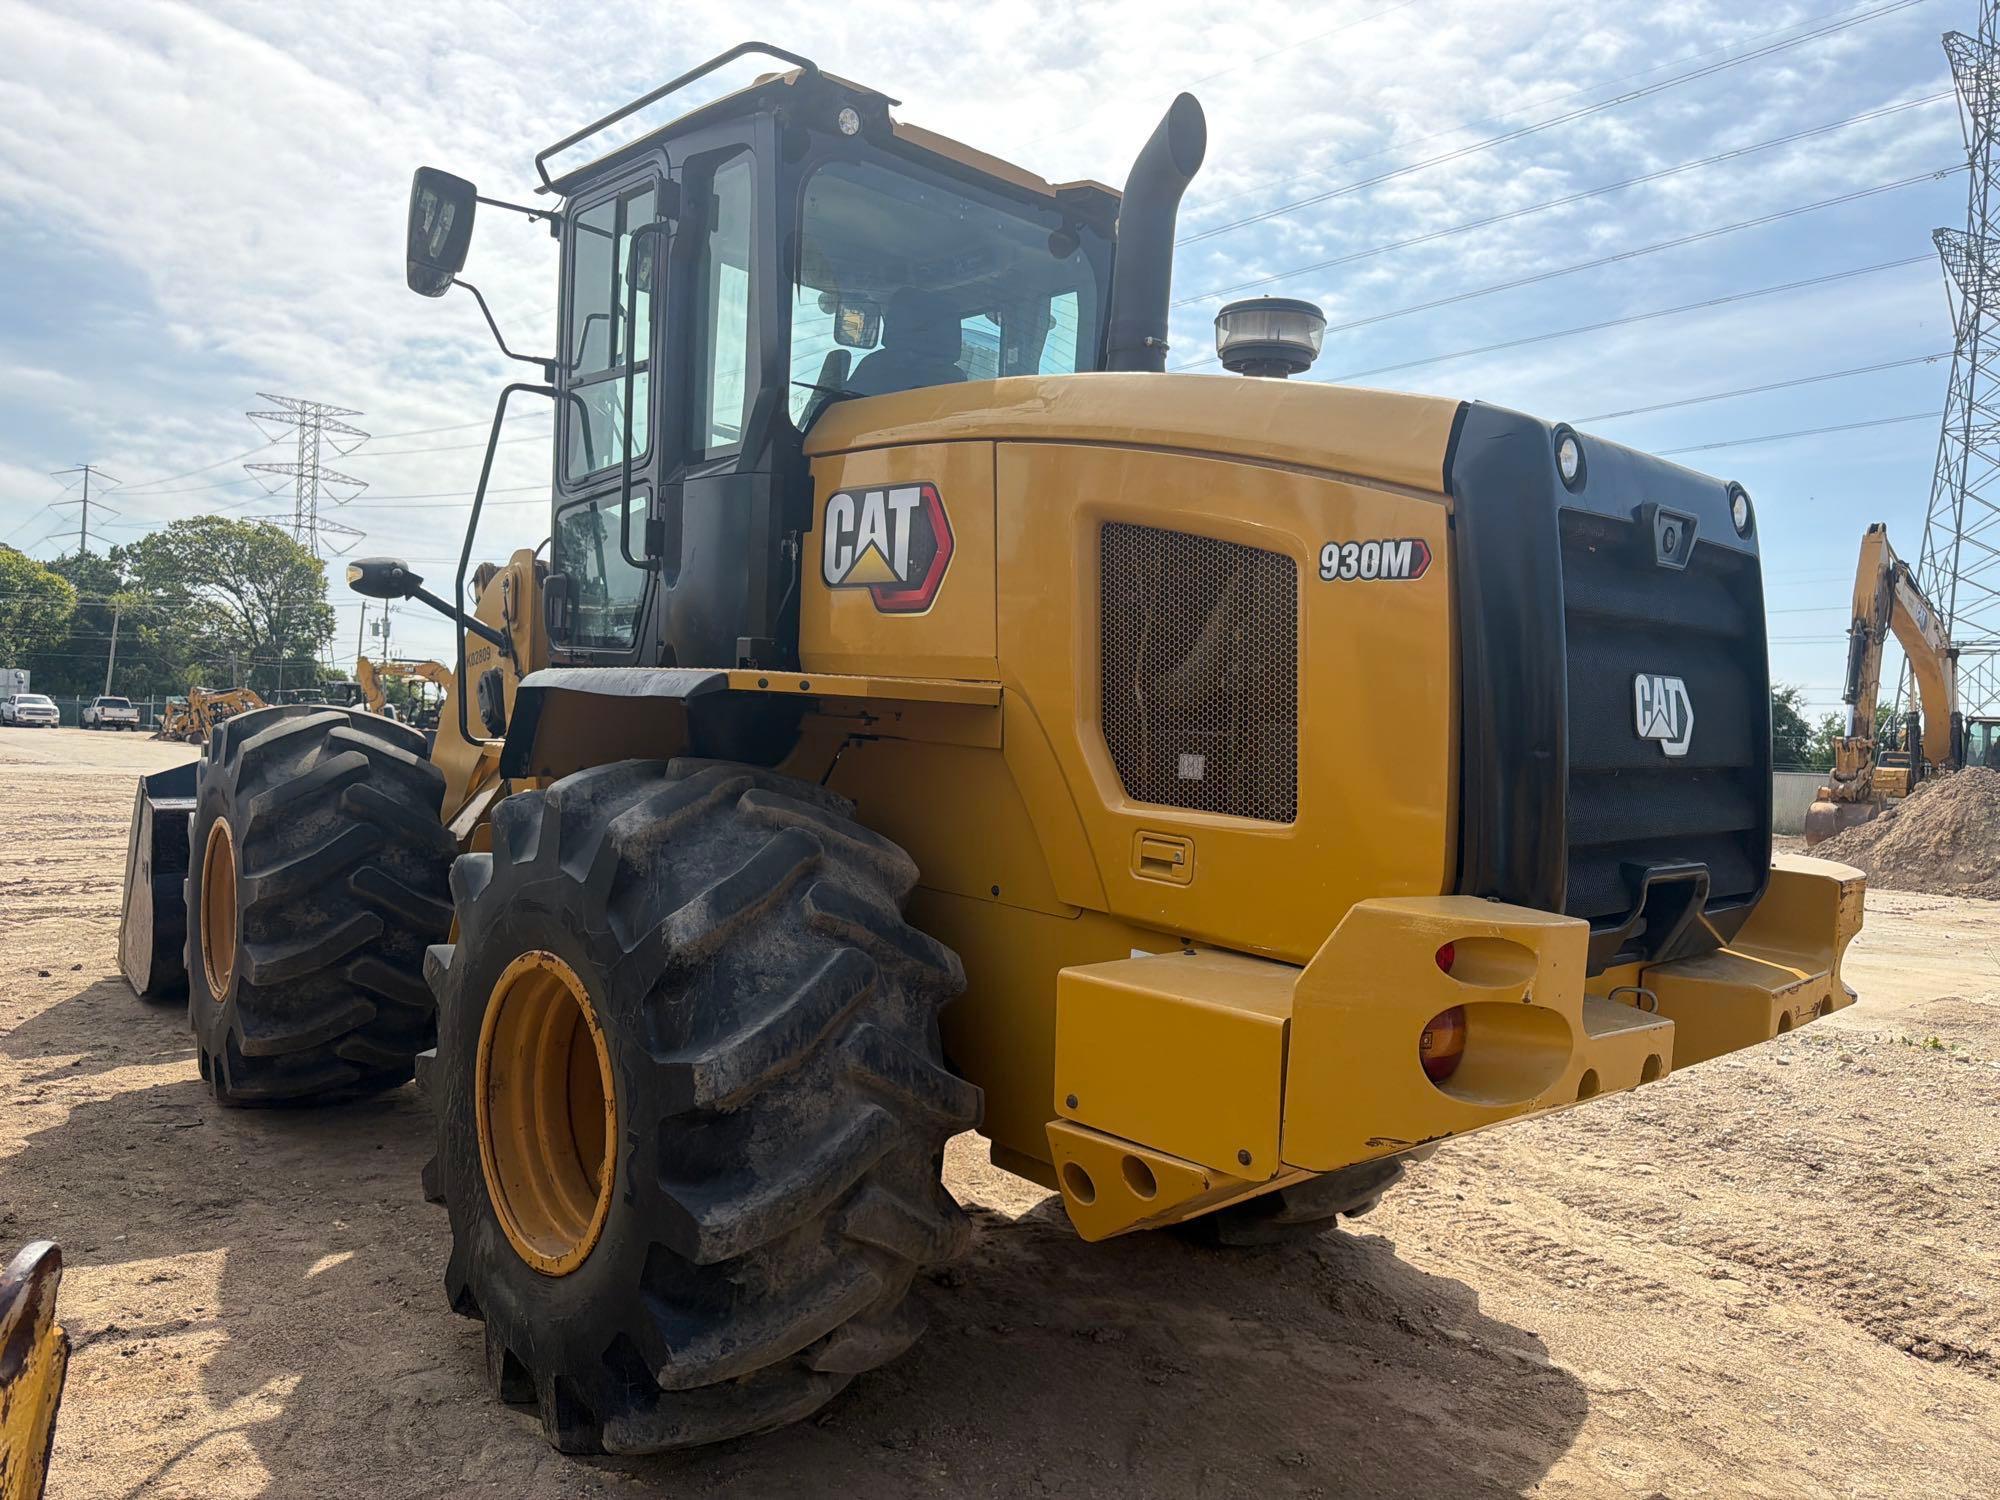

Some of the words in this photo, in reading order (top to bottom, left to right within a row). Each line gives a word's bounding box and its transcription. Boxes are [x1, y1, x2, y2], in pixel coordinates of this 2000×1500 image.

[824, 487, 920, 584] CAT
[1320, 541, 1413, 579] 930M
[1635, 674, 1682, 738] CAT
